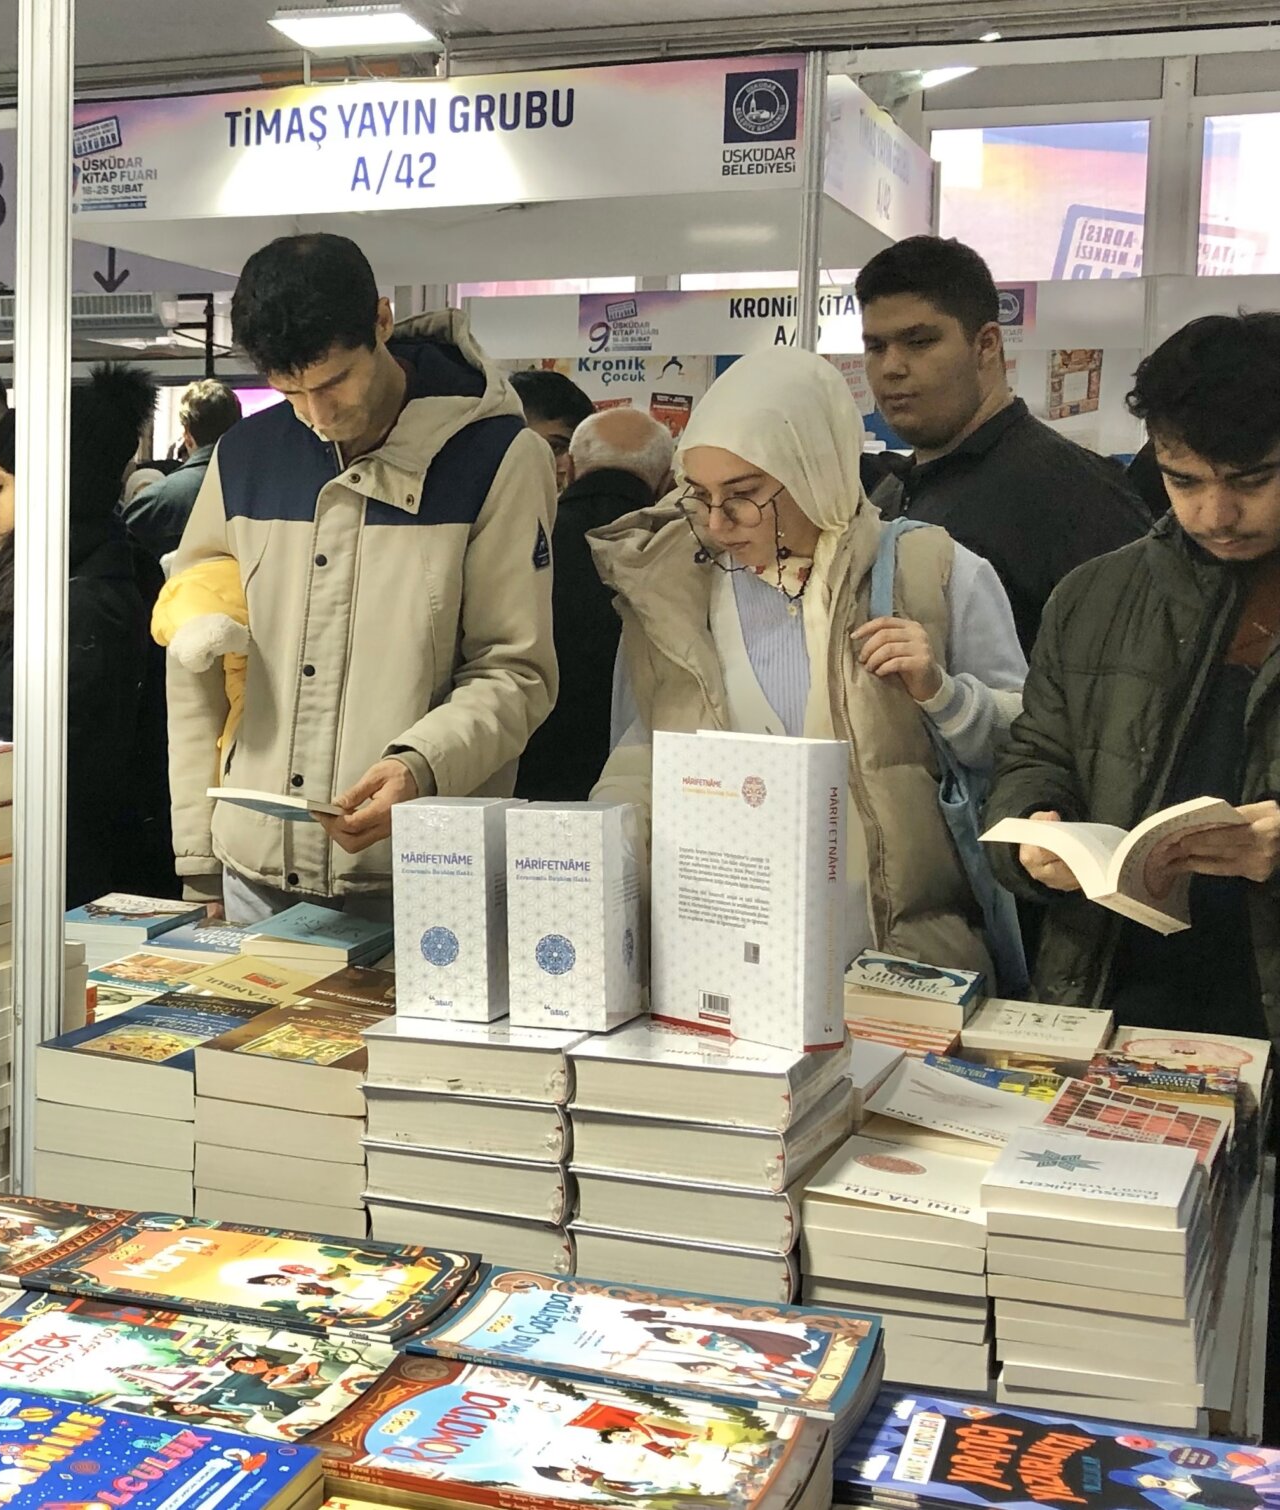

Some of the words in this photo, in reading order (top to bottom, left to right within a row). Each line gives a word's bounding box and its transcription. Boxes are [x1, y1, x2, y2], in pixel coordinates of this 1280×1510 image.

[337, 98, 437, 139] YAYIN
[449, 88, 575, 134] GRUBU
[722, 146, 797, 164] ÜSKÜDAR
[81, 155, 144, 172] ÜSKÜDAR
[120, 168, 158, 182] FUARI
[350, 150, 437, 195] A/42
[110, 183, 144, 196] ŞUBAT
[578, 357, 645, 372] Kronik
[601, 371, 646, 386] Çocuk
